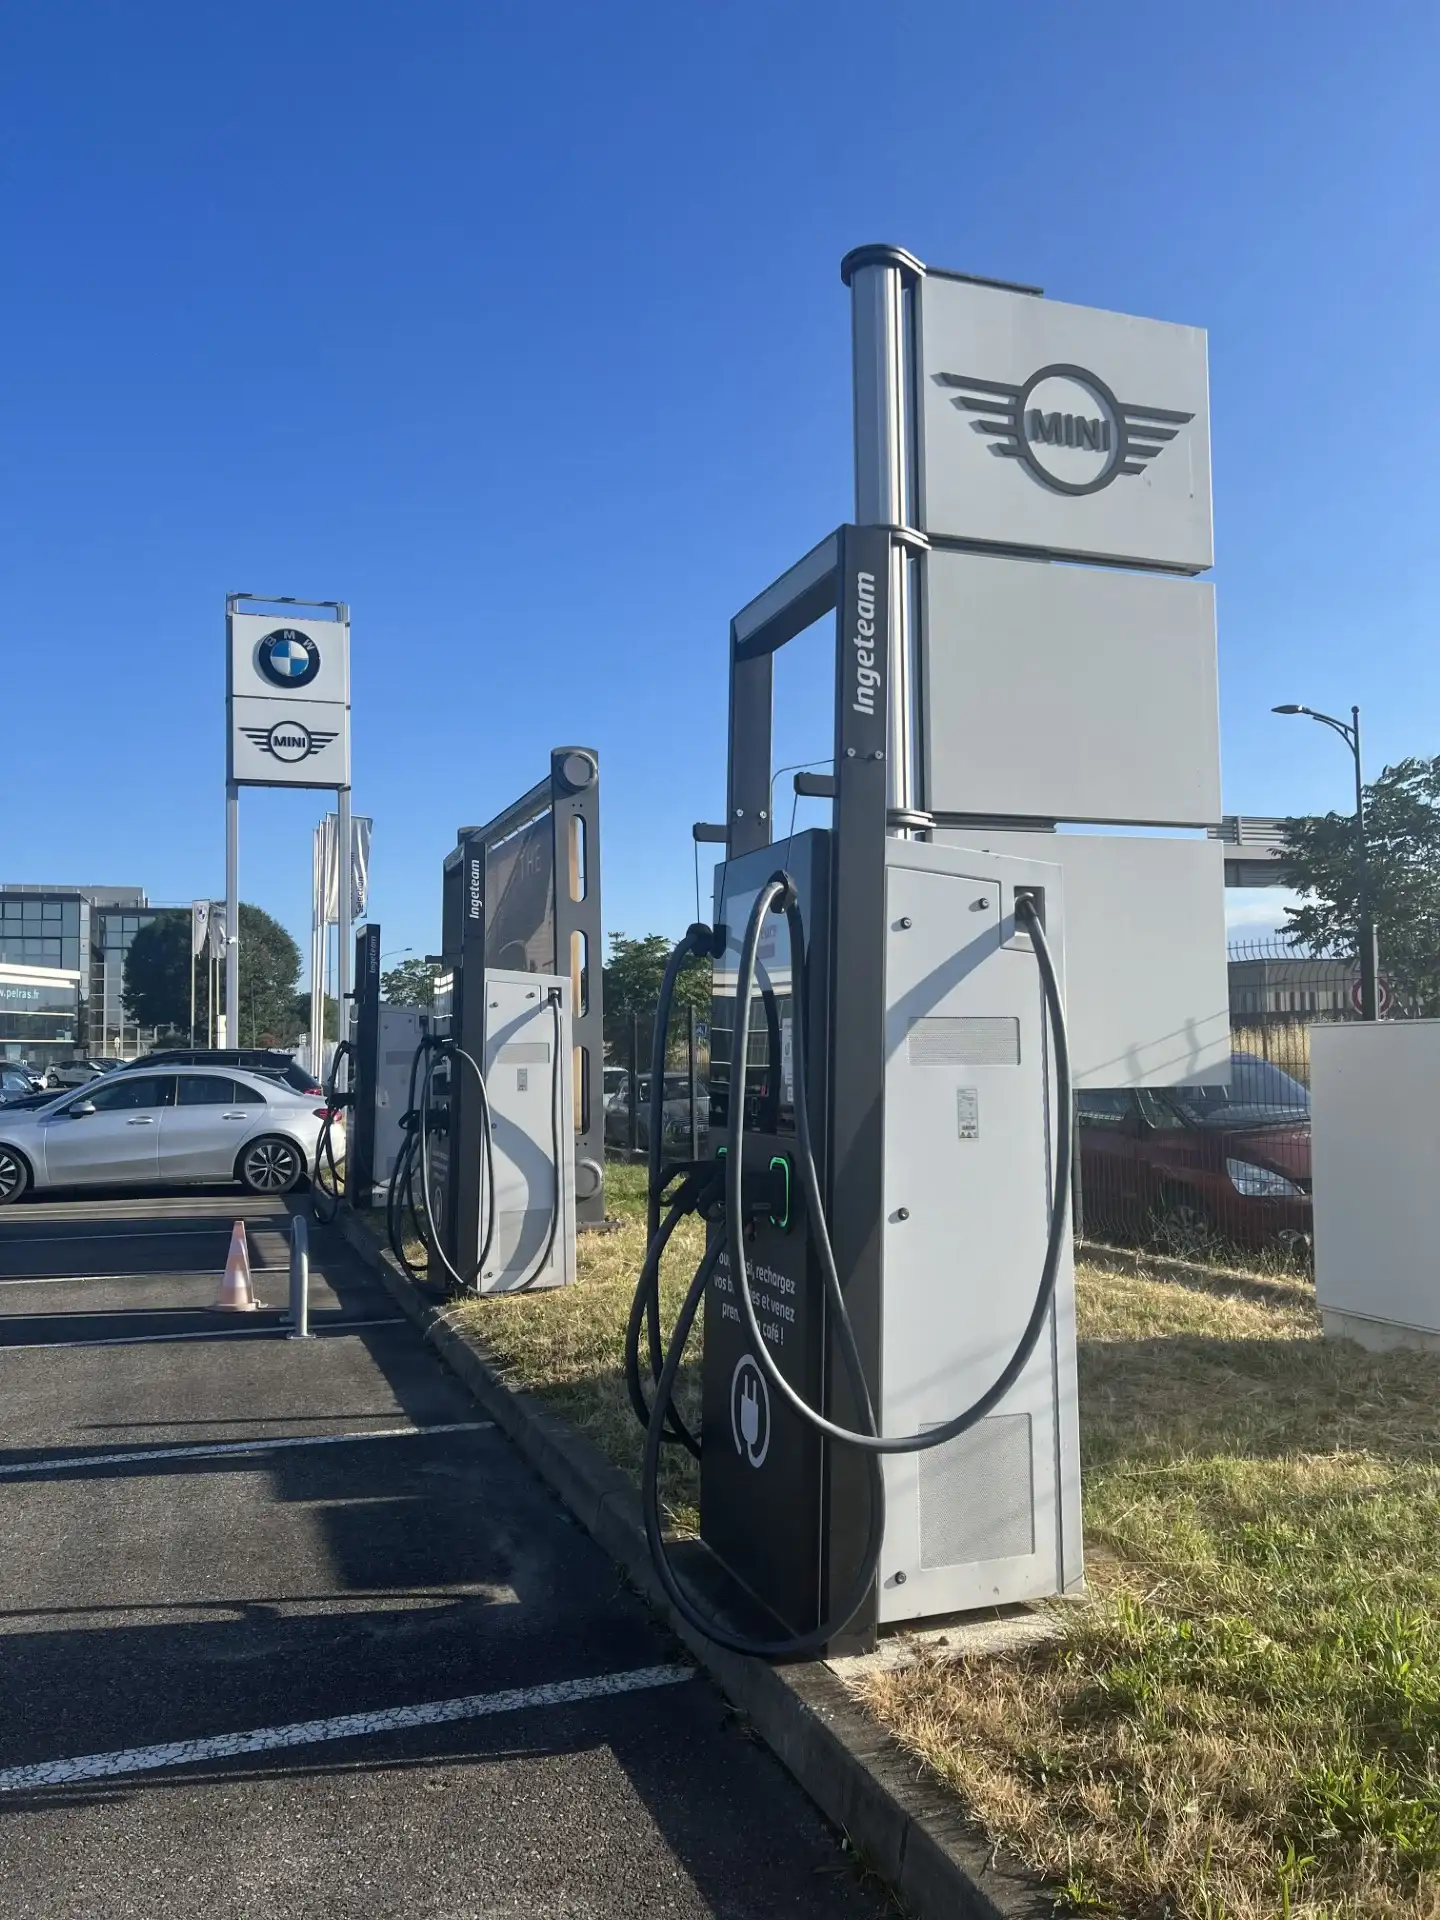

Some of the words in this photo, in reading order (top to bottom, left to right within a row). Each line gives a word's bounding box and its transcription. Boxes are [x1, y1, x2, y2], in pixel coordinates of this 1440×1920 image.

[1030, 408, 1111, 450] MINI
[265, 630, 315, 650] BMW
[853, 571, 880, 715] Ingeteam
[273, 736, 306, 748] MINI
[469, 860, 482, 919] Ingeteam
[369, 936, 378, 974] Ingeteam
[714, 1275, 726, 1291] vos
[761, 1294, 770, 1310] et
[771, 1299, 796, 1323] venez
[755, 1265, 796, 1295] rechargez
[763, 1321, 779, 1343] café
